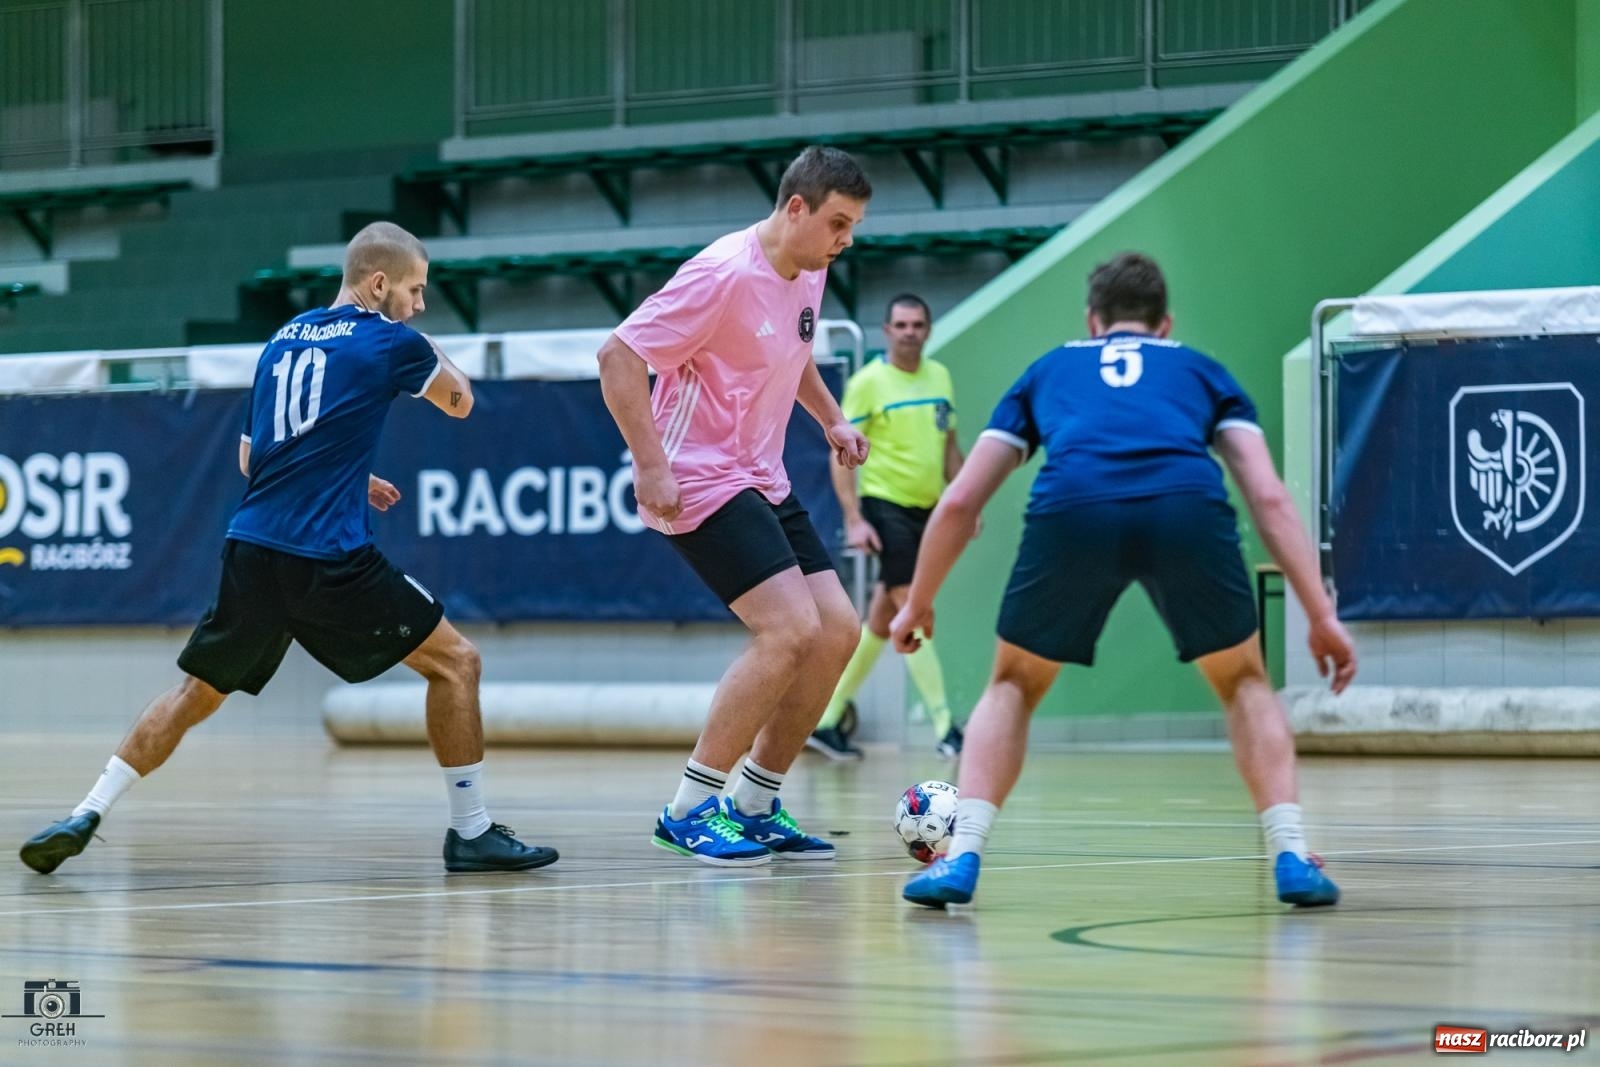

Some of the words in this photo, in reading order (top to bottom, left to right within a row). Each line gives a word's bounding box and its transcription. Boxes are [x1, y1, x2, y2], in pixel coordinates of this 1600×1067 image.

[299, 320, 357, 341] RACIBÓRZ
[1100, 342, 1144, 388] 5
[272, 347, 327, 442] 10
[30, 536, 132, 571] RACIBÓRZ
